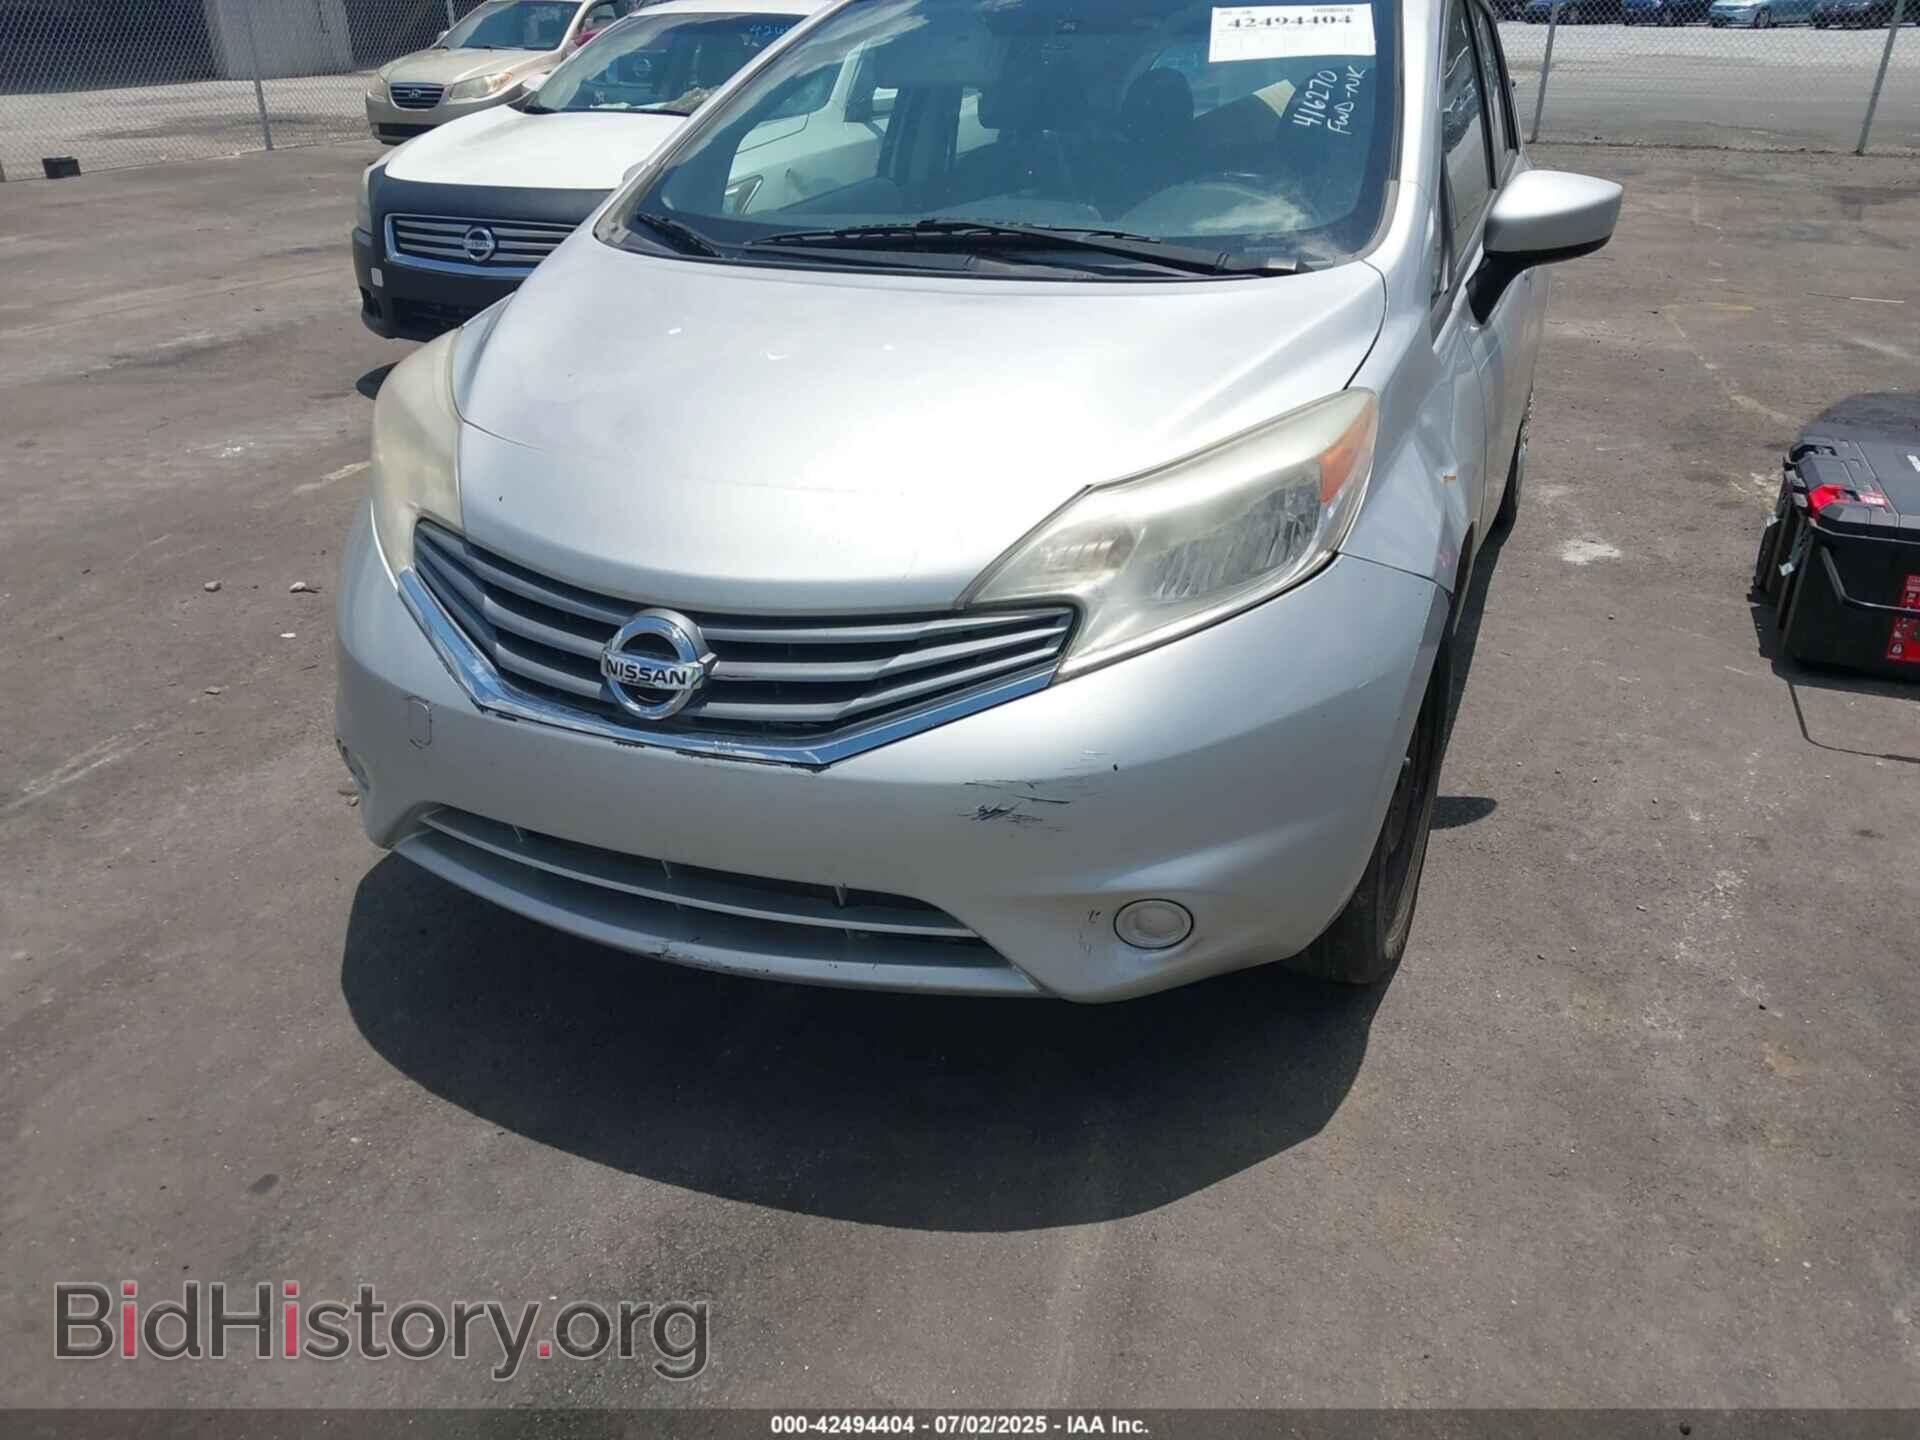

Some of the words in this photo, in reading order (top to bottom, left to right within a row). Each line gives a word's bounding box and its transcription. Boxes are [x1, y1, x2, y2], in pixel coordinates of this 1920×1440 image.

[1227, 14, 1353, 29] 42494404
[1292, 69, 1338, 128] 416270
[605, 659, 687, 686] NISSAN
